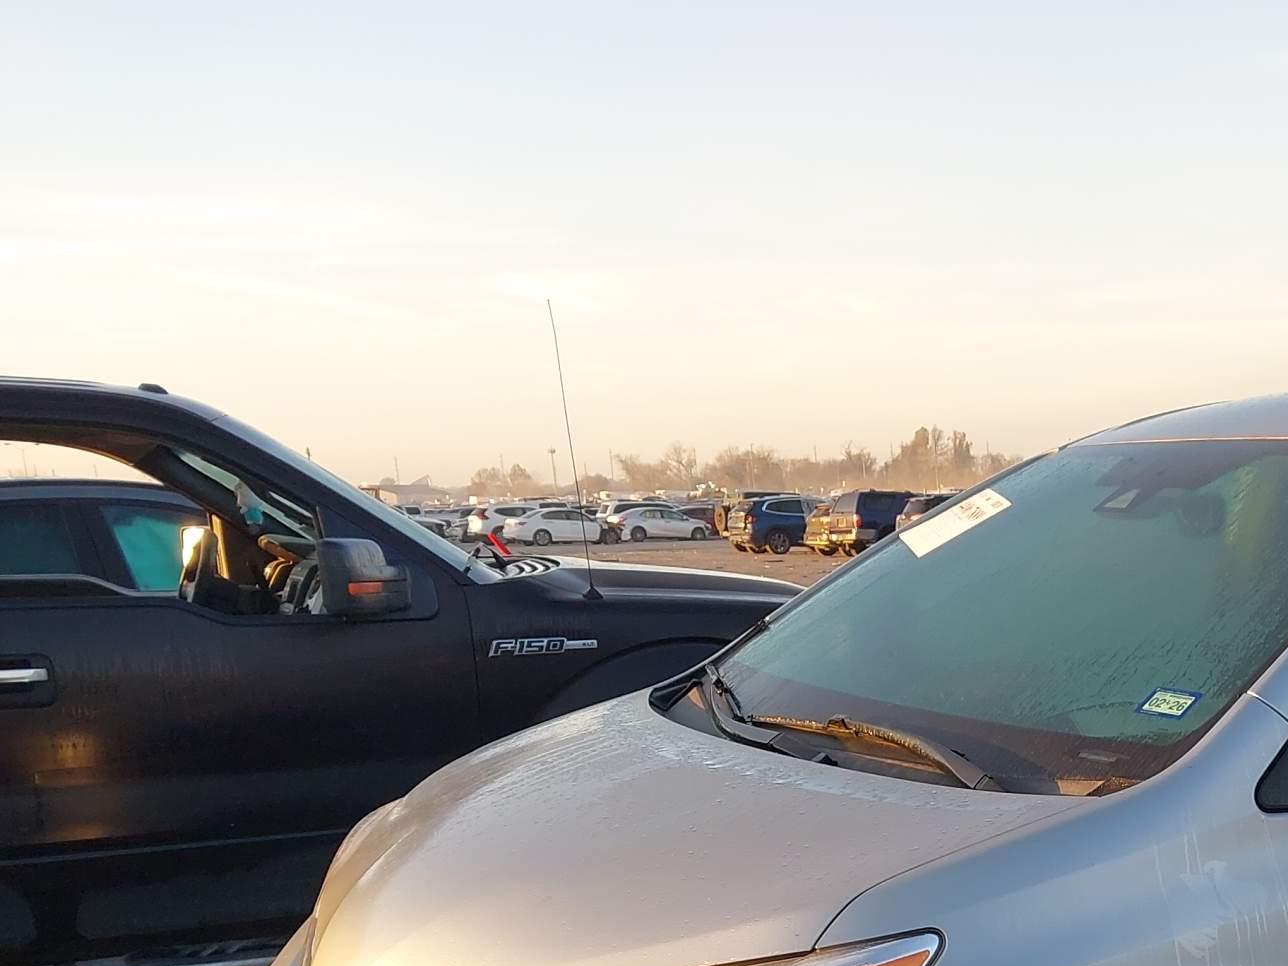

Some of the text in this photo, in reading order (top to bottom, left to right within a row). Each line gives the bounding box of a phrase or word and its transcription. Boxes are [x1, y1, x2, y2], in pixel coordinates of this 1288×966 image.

[488, 637, 567, 657] F-150
[1148, 697, 1167, 708] 02
[1168, 700, 1188, 712] 26
